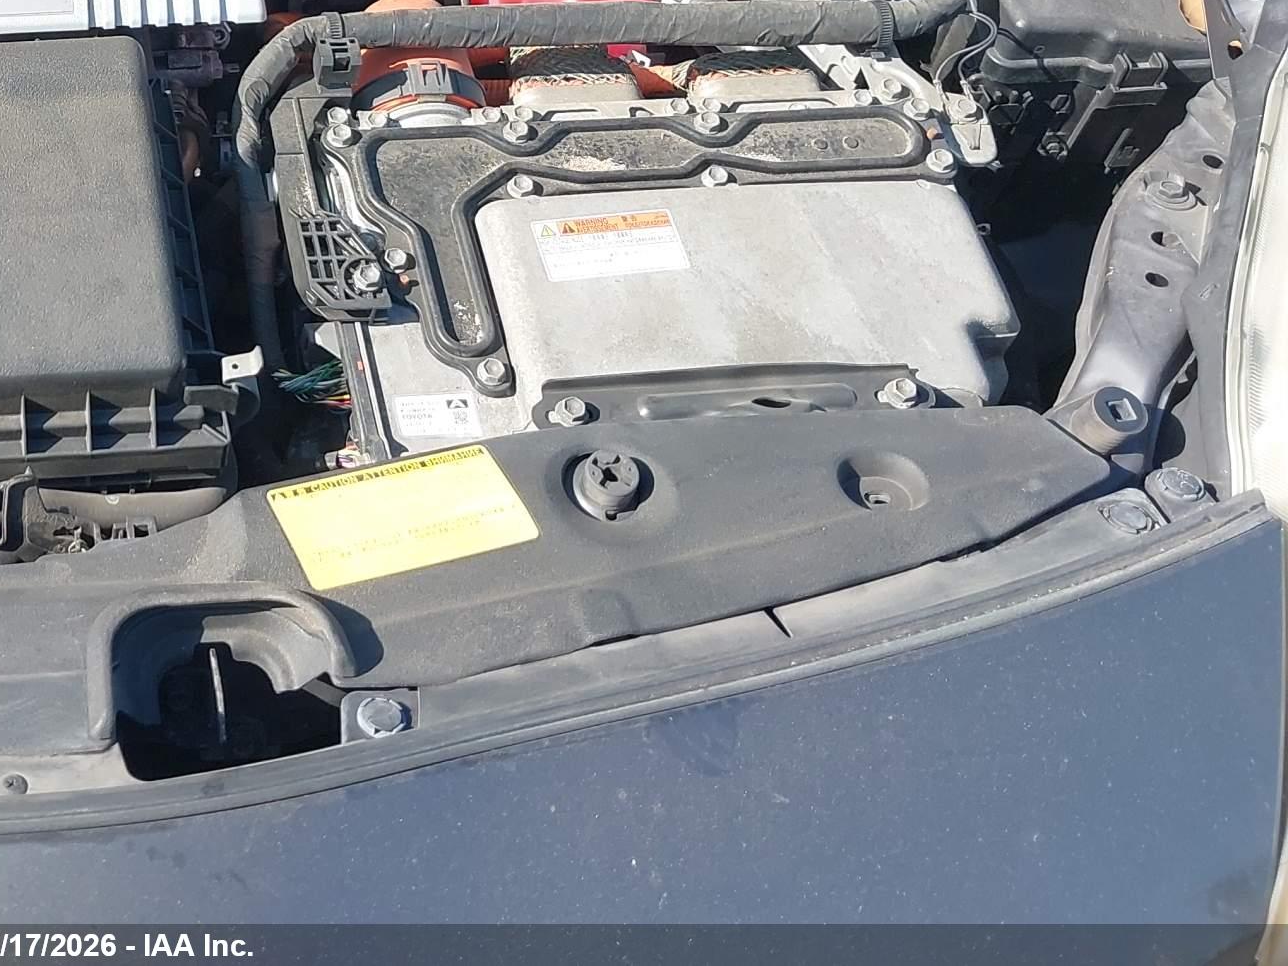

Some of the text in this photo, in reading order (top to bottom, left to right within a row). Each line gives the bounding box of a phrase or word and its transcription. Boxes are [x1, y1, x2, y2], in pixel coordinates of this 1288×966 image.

[575, 217, 609, 227] WARNING
[312, 475, 358, 492] CAUTION
[362, 461, 421, 482] ATTENTION
